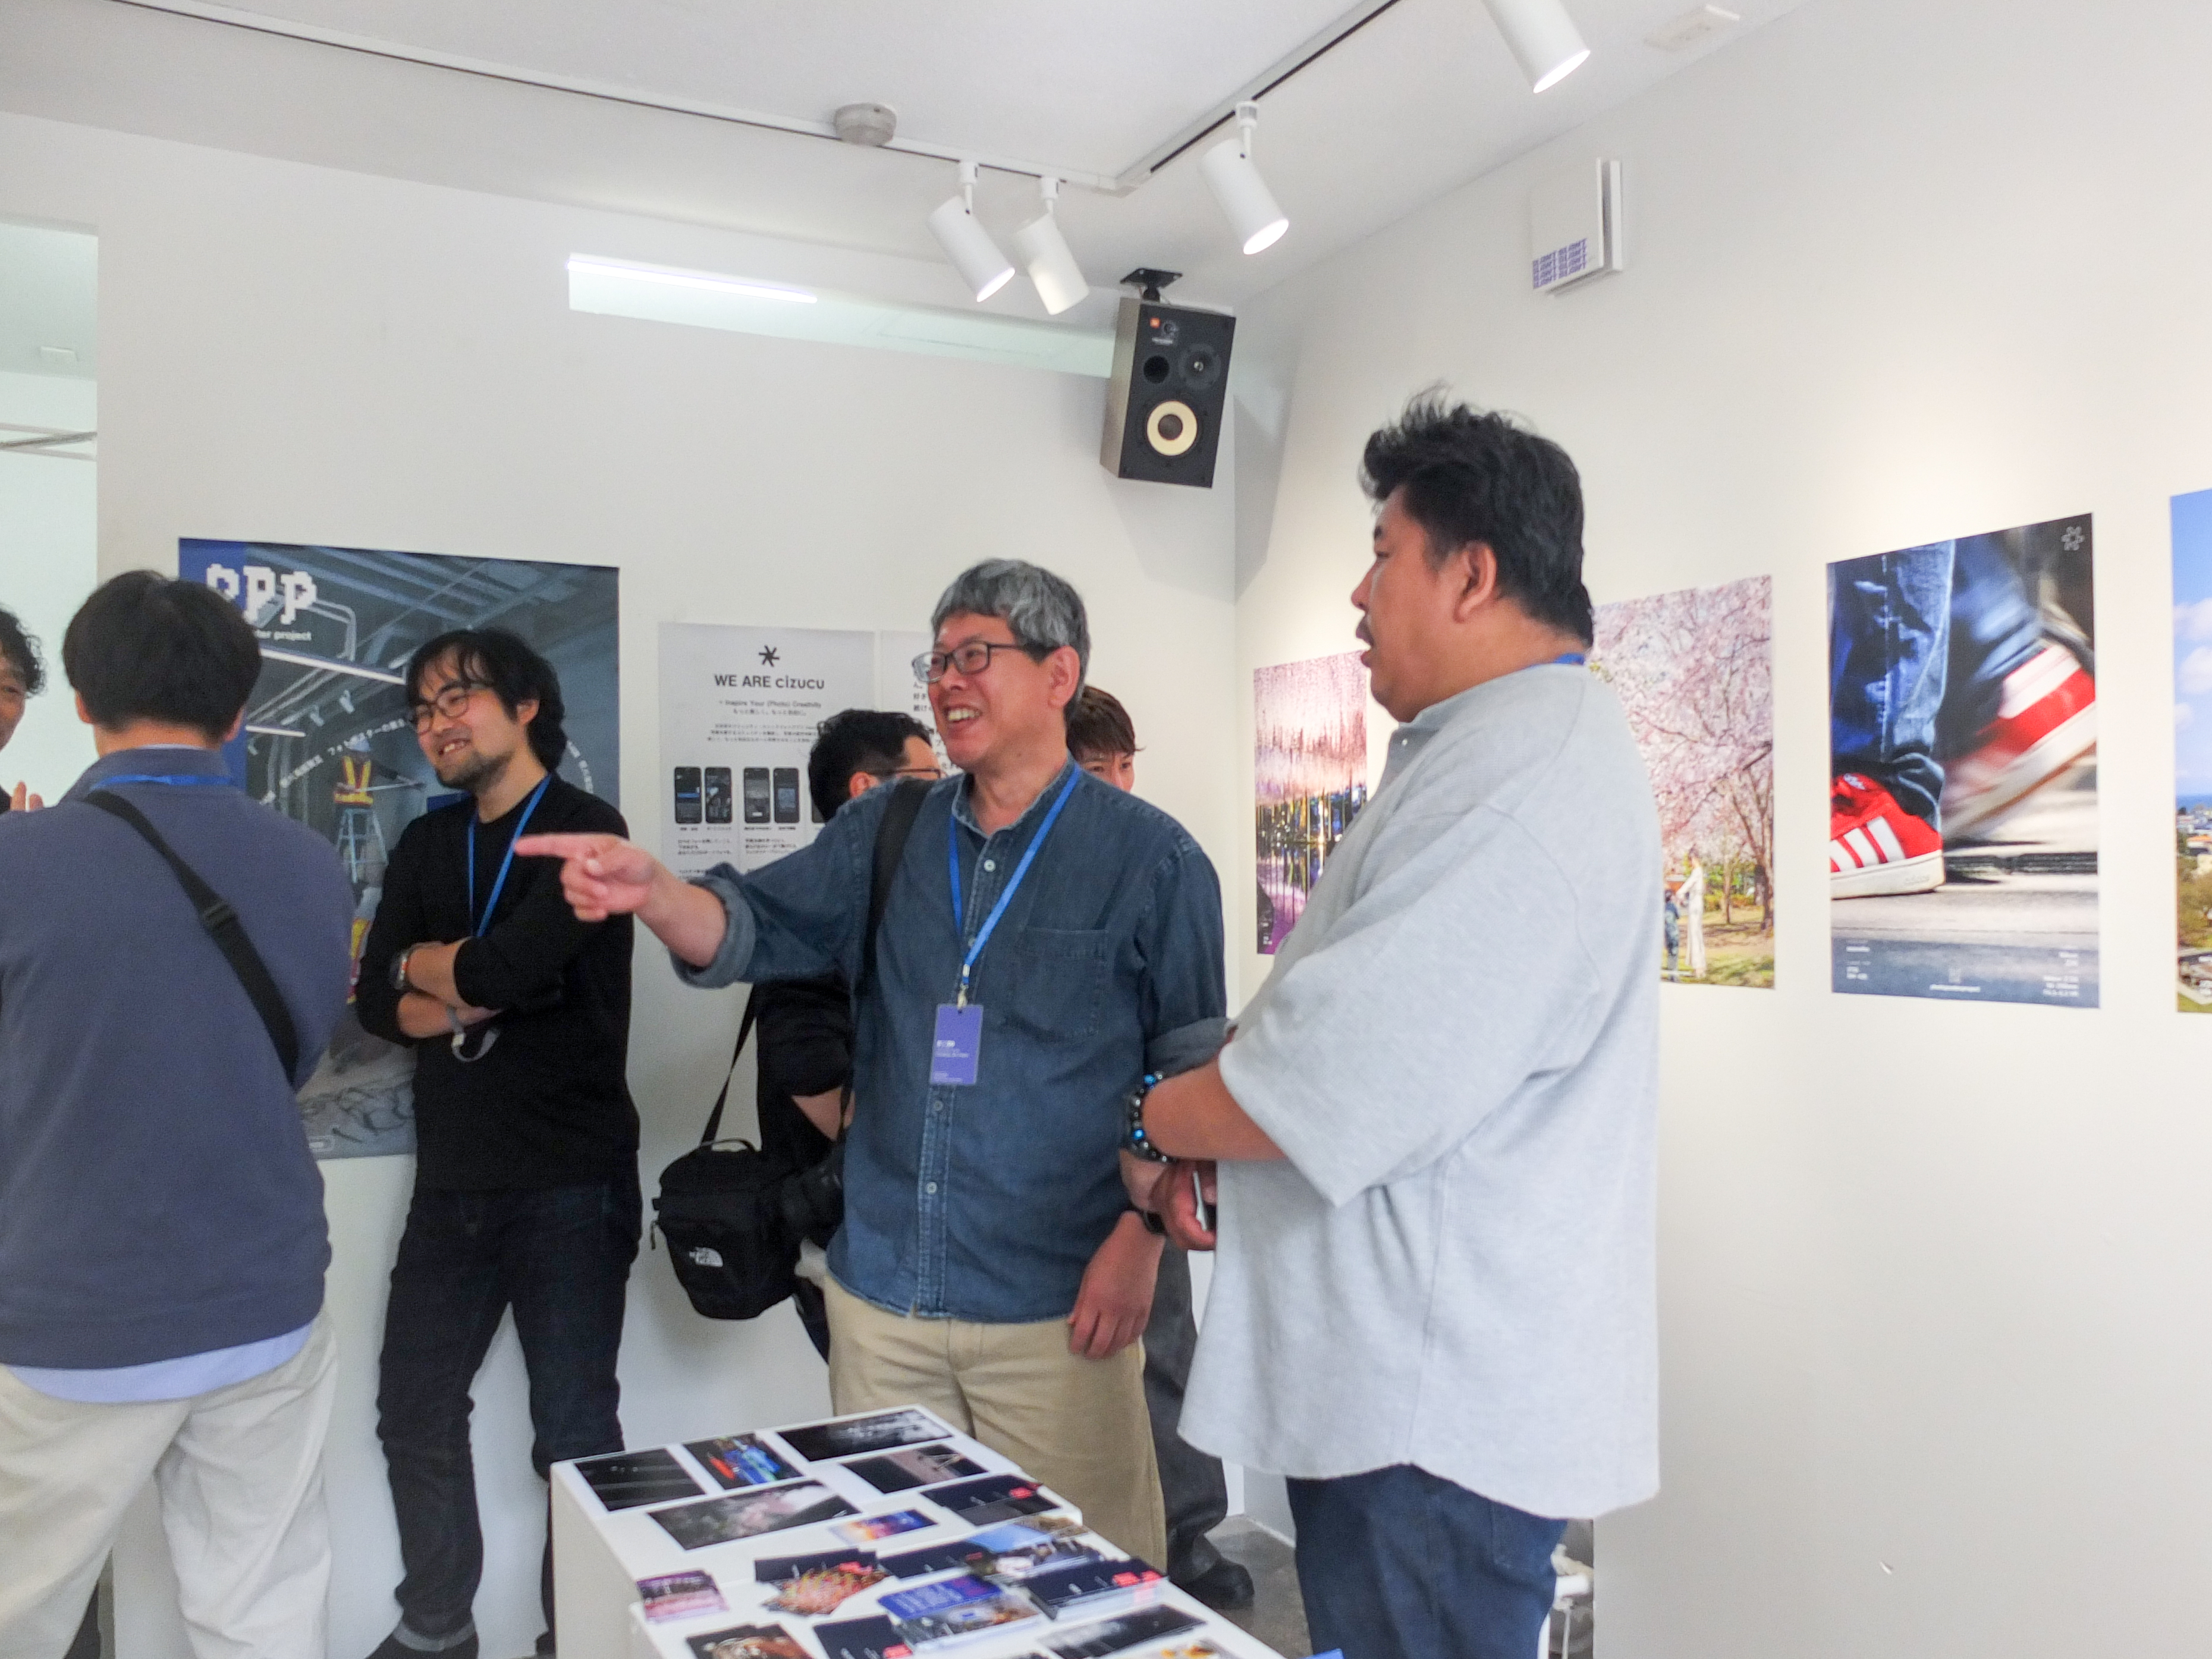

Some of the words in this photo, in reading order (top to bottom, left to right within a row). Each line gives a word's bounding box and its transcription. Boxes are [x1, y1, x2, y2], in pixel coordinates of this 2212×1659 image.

[715, 674, 737, 687] WE
[742, 675, 772, 688] ARE
[775, 675, 825, 689] cizucu
